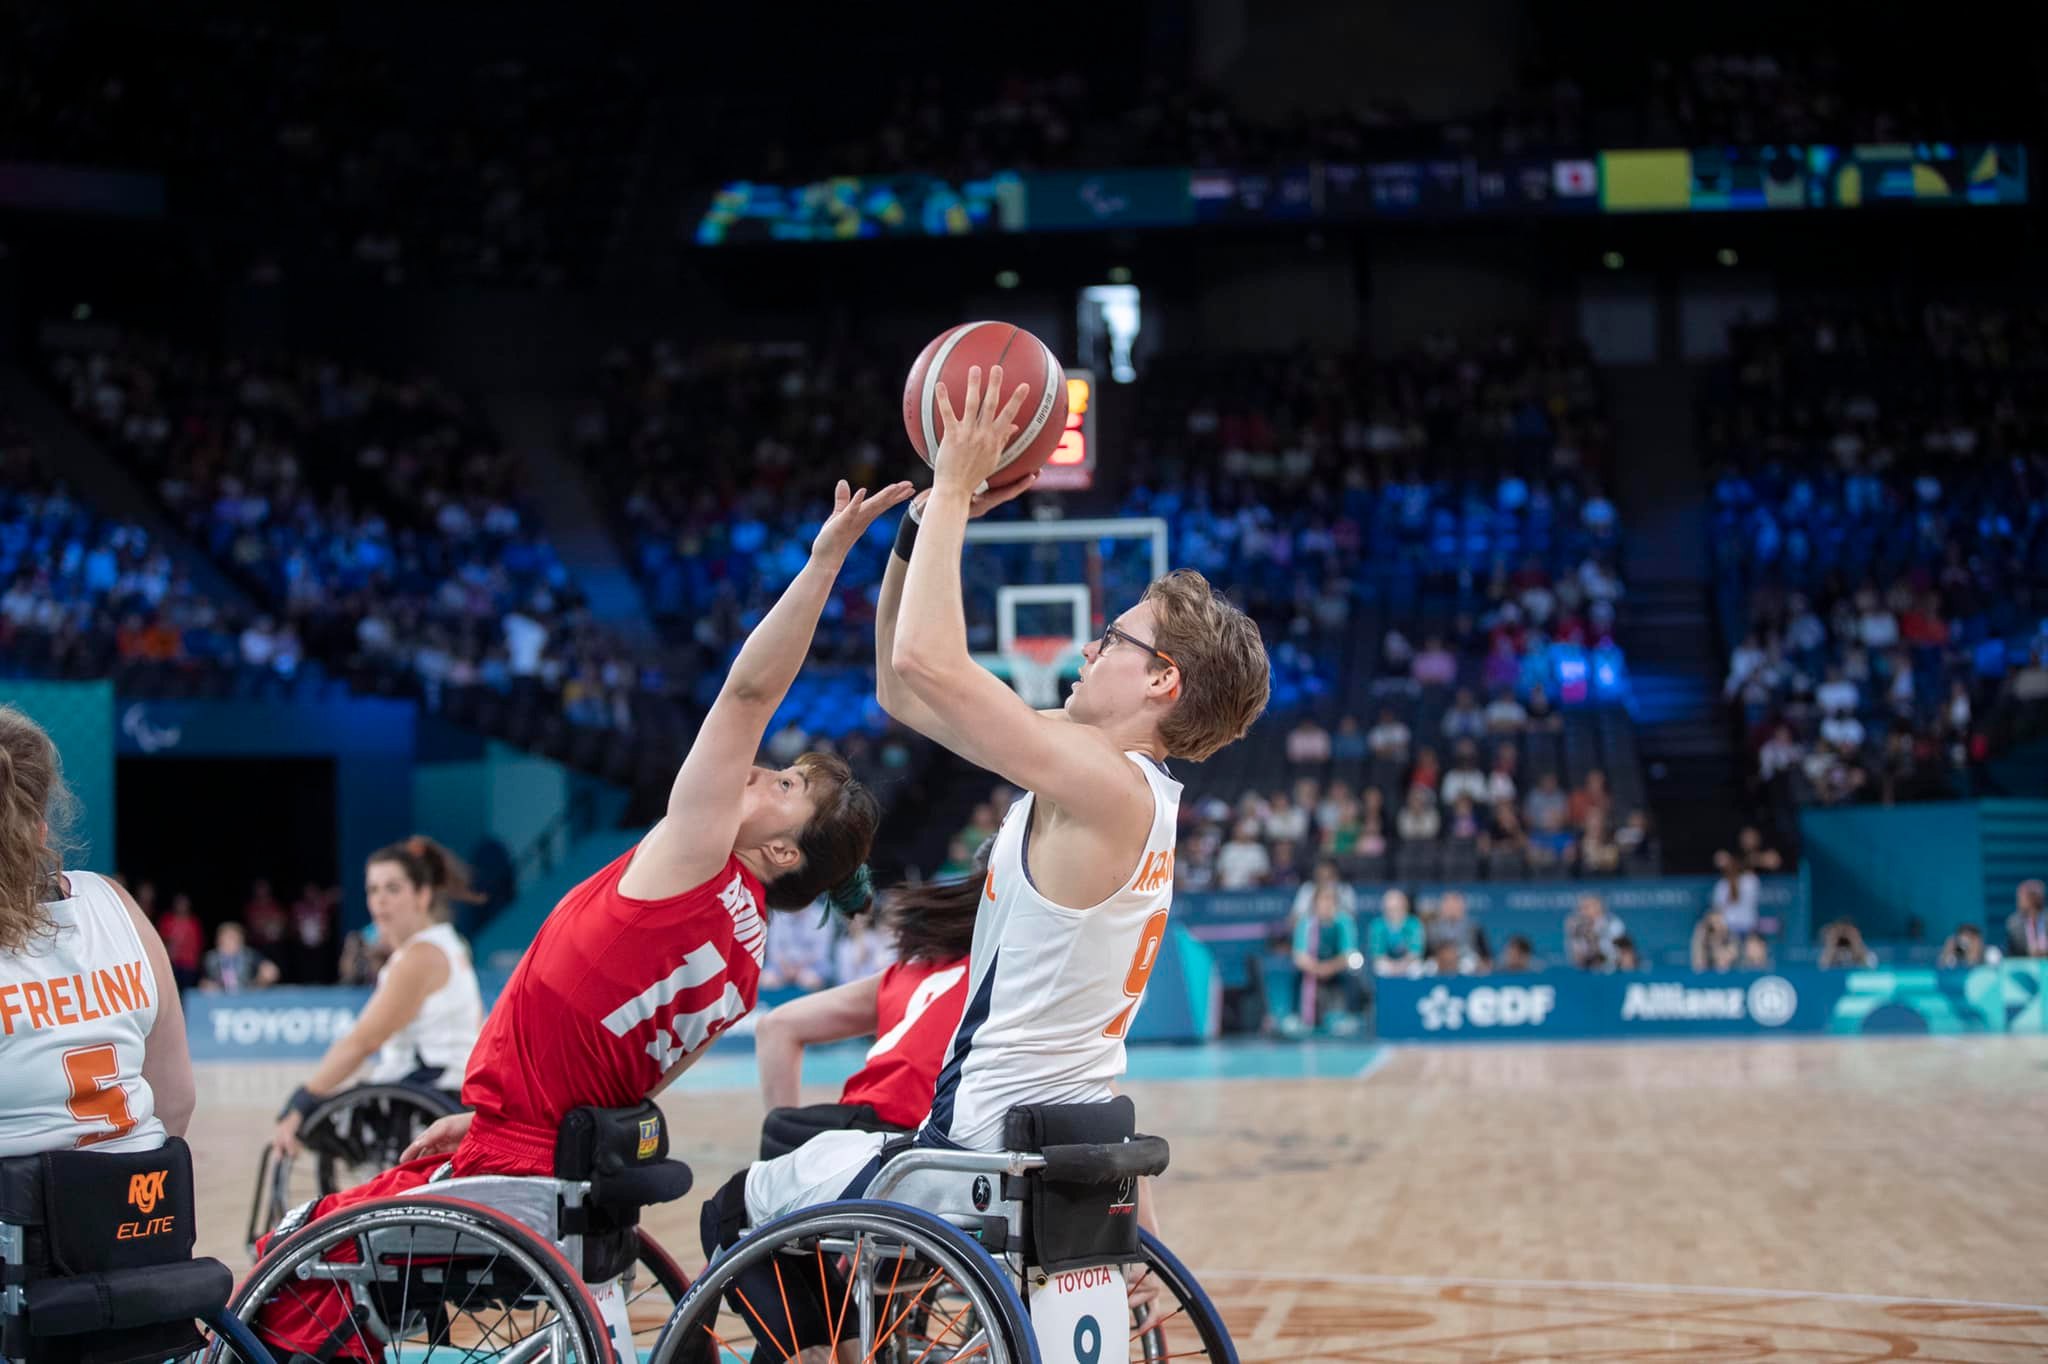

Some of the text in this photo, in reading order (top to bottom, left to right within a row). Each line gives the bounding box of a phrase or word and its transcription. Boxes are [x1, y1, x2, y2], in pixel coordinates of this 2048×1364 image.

[0, 961, 150, 1035] FRELINK
[1102, 908, 1168, 1038] 9
[1621, 982, 1746, 1021] Allianz
[62, 1042, 138, 1149] 5
[116, 1215, 175, 1241] ELITE
[1055, 1265, 1112, 1294] TOYOTA
